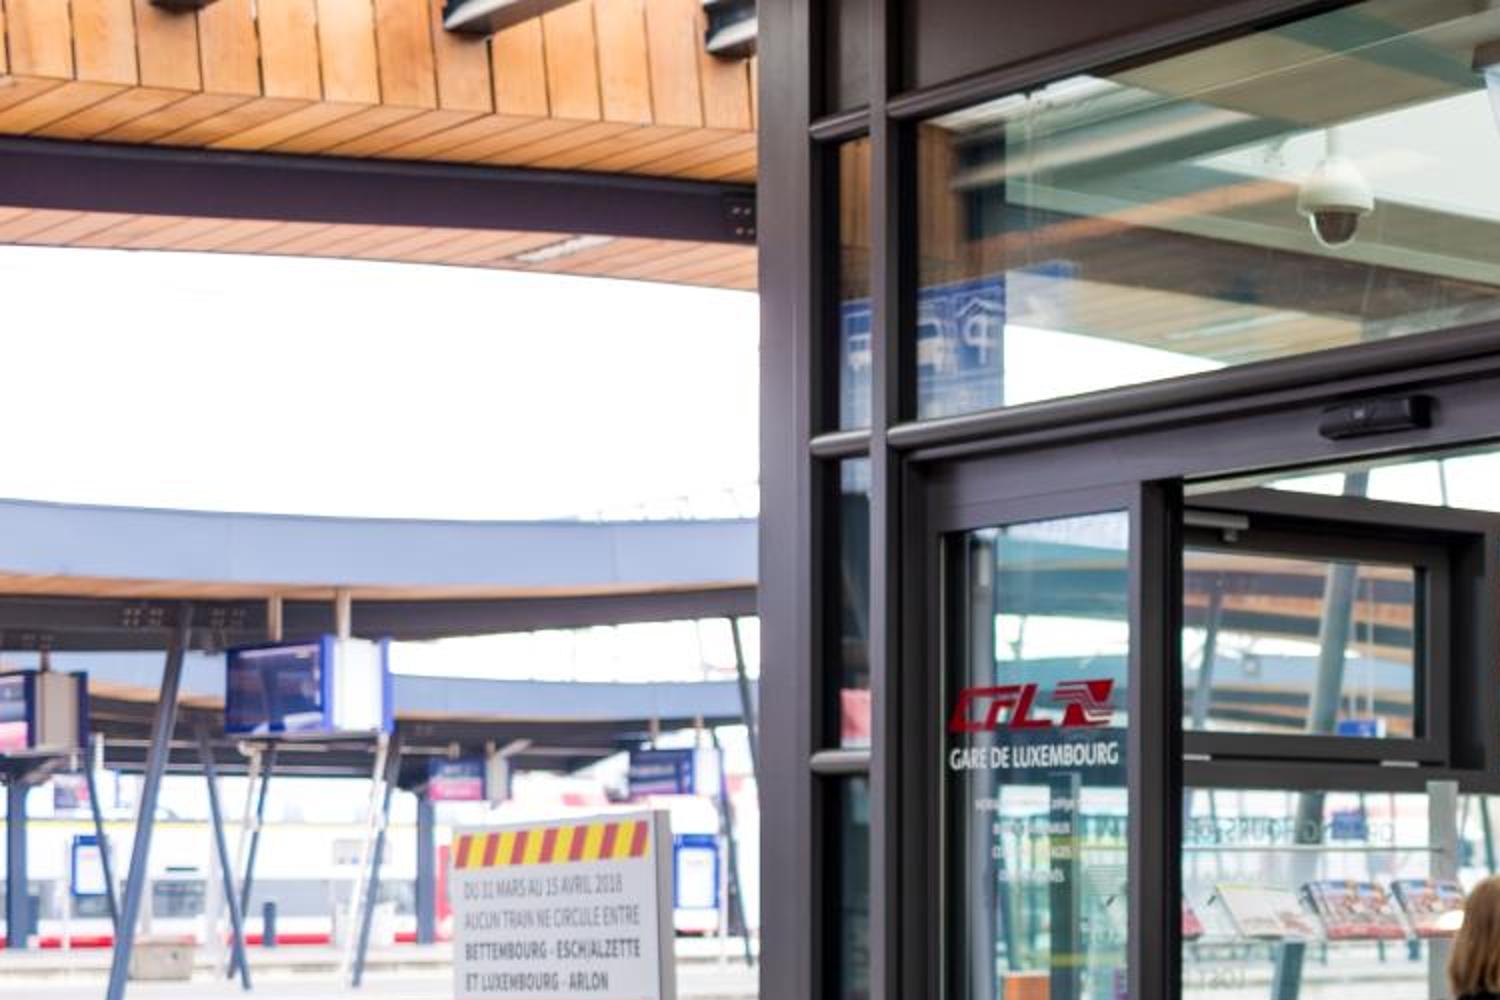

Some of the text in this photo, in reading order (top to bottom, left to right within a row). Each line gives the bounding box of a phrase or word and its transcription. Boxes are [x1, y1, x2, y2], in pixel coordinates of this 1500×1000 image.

[950, 742, 1119, 771] GARE DE LUXEMBOURG
[496, 878, 527, 898] MARS
[528, 877, 543, 897] AU
[545, 876, 558, 896] 15
[560, 874, 592, 895] AVRIL
[595, 872, 623, 894] 2018
[464, 904, 640, 929] AUCUN TRAIN NE CIRCULE ENTRE
[465, 941, 547, 961] BETTEMBOURG
[466, 972, 478, 991] ET
[481, 971, 559, 991] LUXEMBOURG
[569, 971, 608, 991] ARLON
